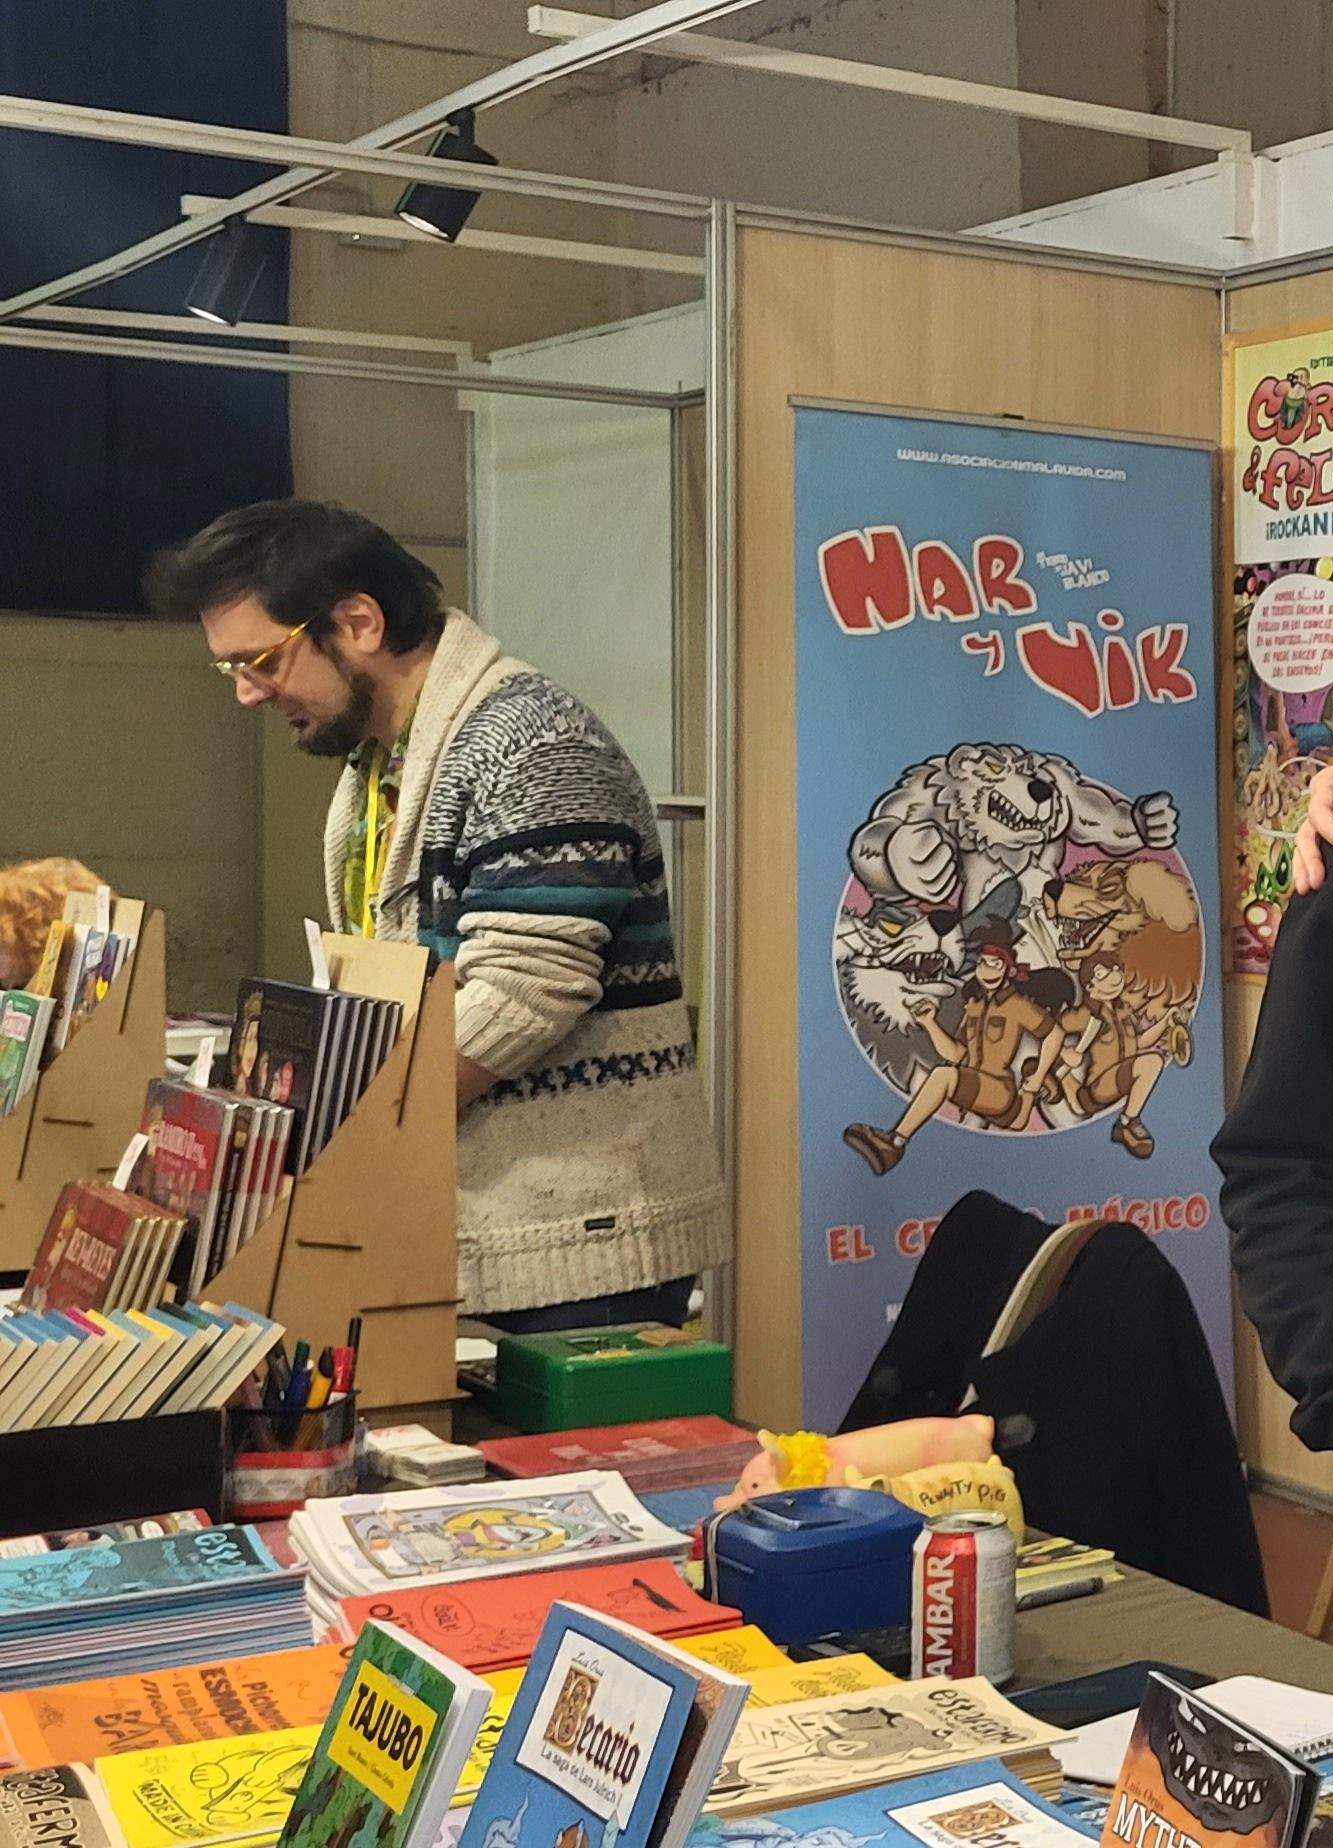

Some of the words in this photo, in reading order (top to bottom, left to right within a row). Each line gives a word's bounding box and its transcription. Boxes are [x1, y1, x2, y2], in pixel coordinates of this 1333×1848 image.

[827, 1225, 874, 1265] EL
[927, 1553, 956, 1681] AMBAR
[348, 1682, 423, 1772] TAJUBO
[544, 1665, 641, 1785] Becario
[1112, 1791, 1201, 1848] MYTH
